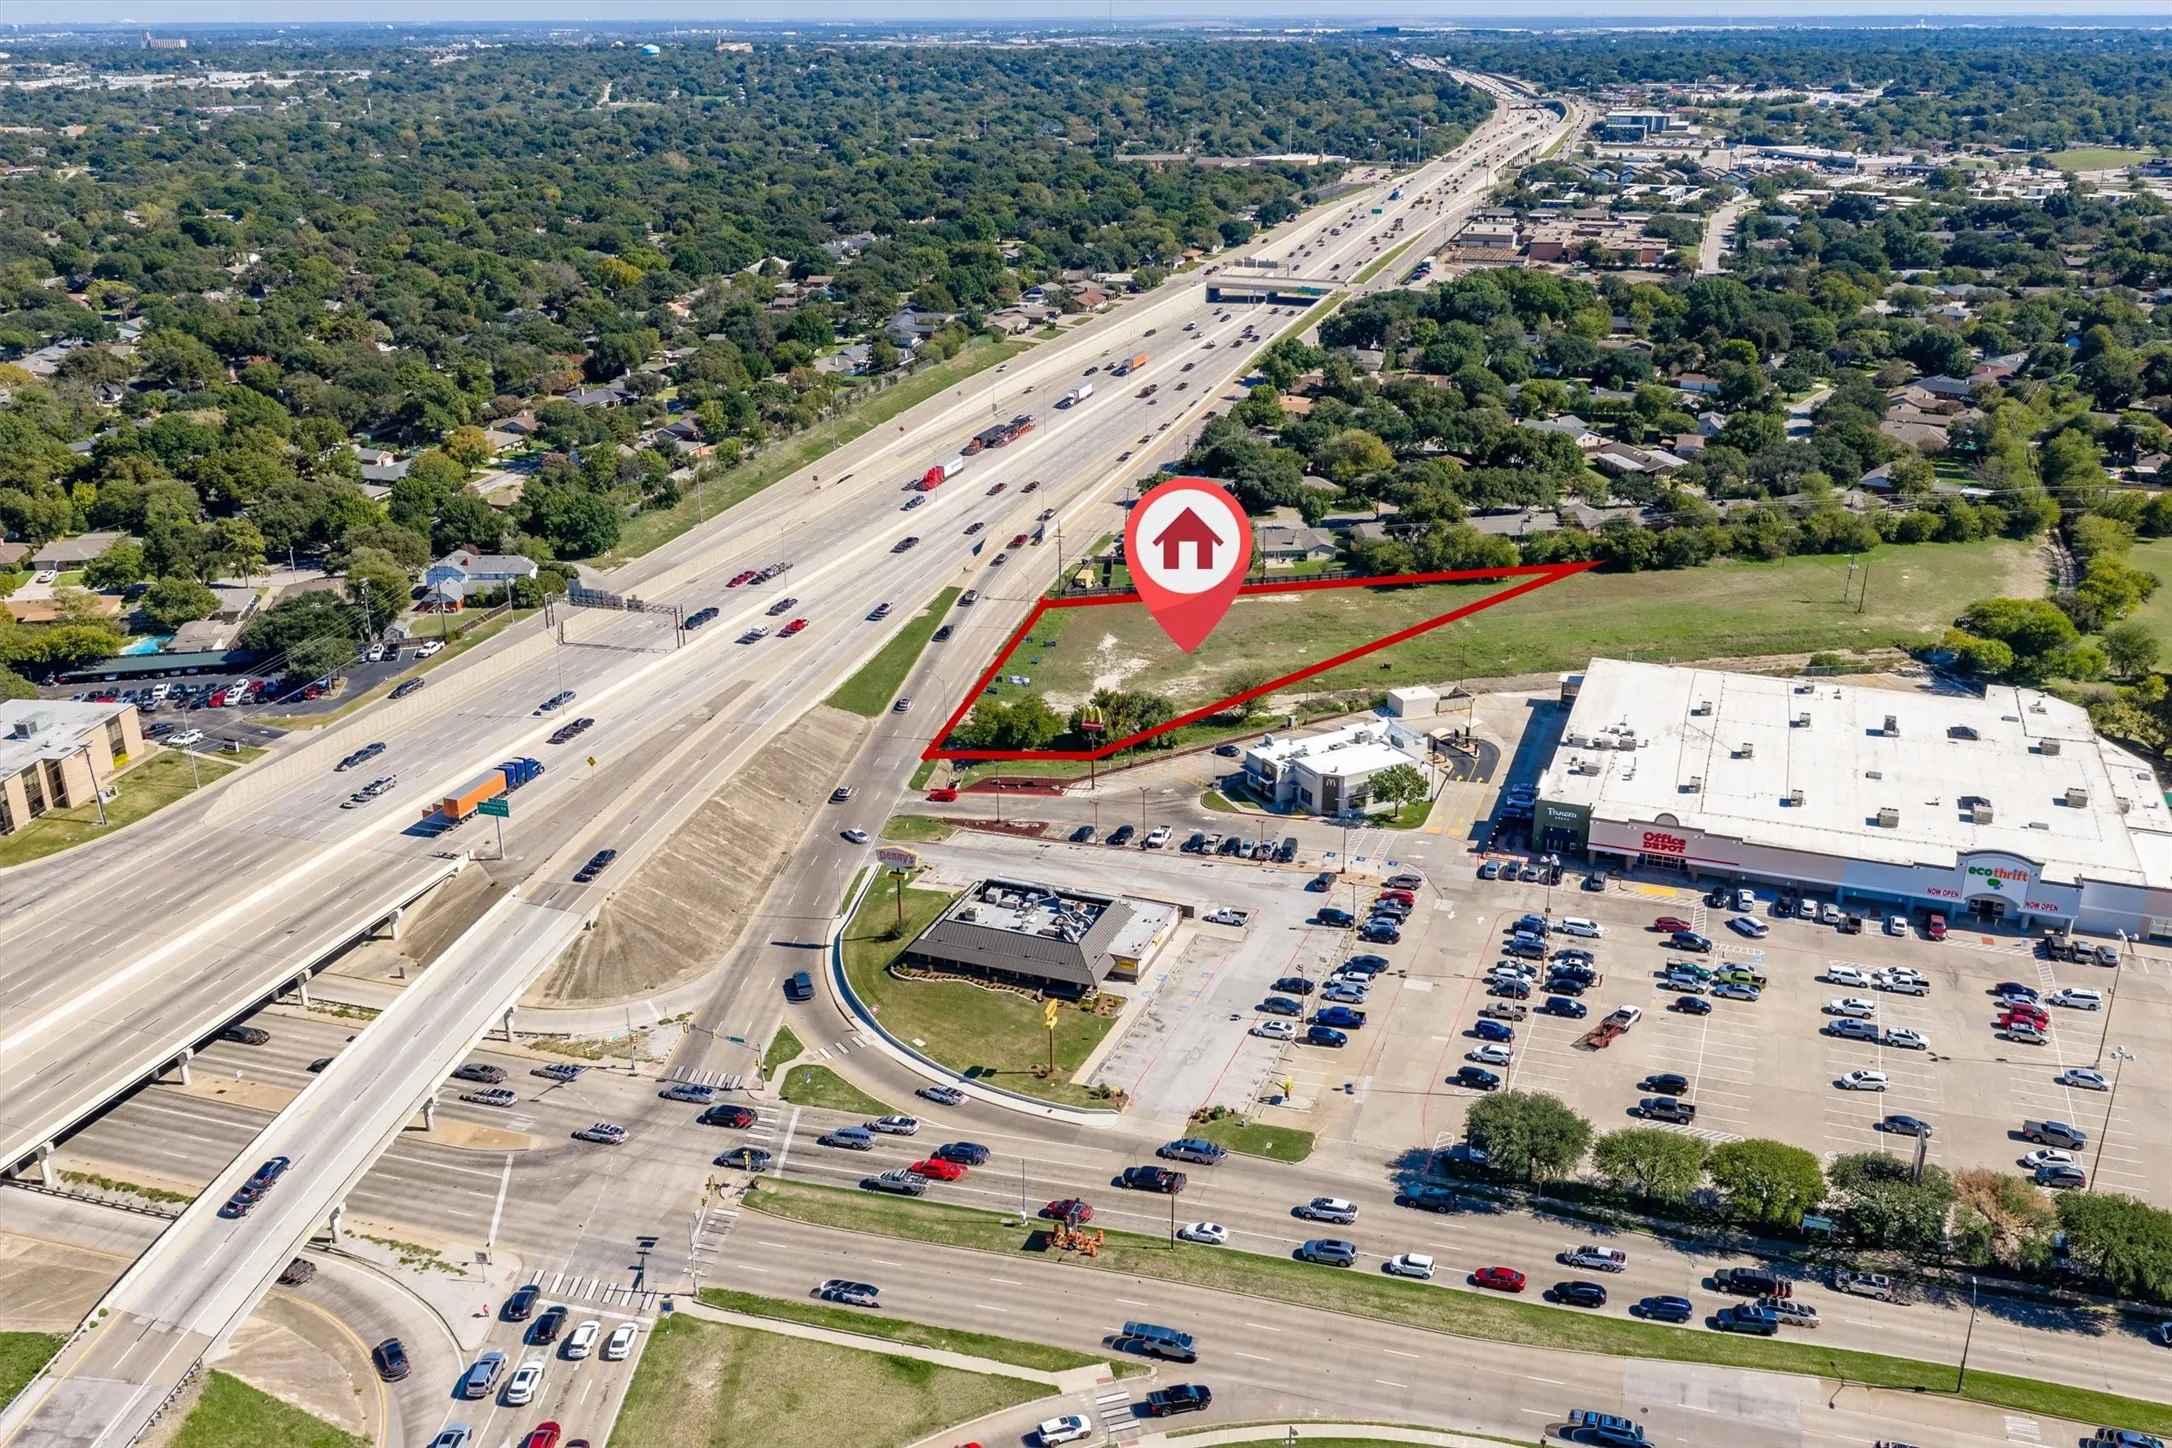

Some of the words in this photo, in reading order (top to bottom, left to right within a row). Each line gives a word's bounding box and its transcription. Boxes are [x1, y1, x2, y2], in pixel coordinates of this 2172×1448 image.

[1547, 807, 1577, 818] Panera
[1643, 832, 1686, 847] Office
[1642, 841, 1686, 853] DEPOT
[879, 851, 915, 864] Denny's
[1927, 887, 1942, 896] NOW
[1942, 889, 1960, 898] OPEN
[2024, 901, 2040, 910] NOW
[2040, 903, 2059, 912] OPEN
